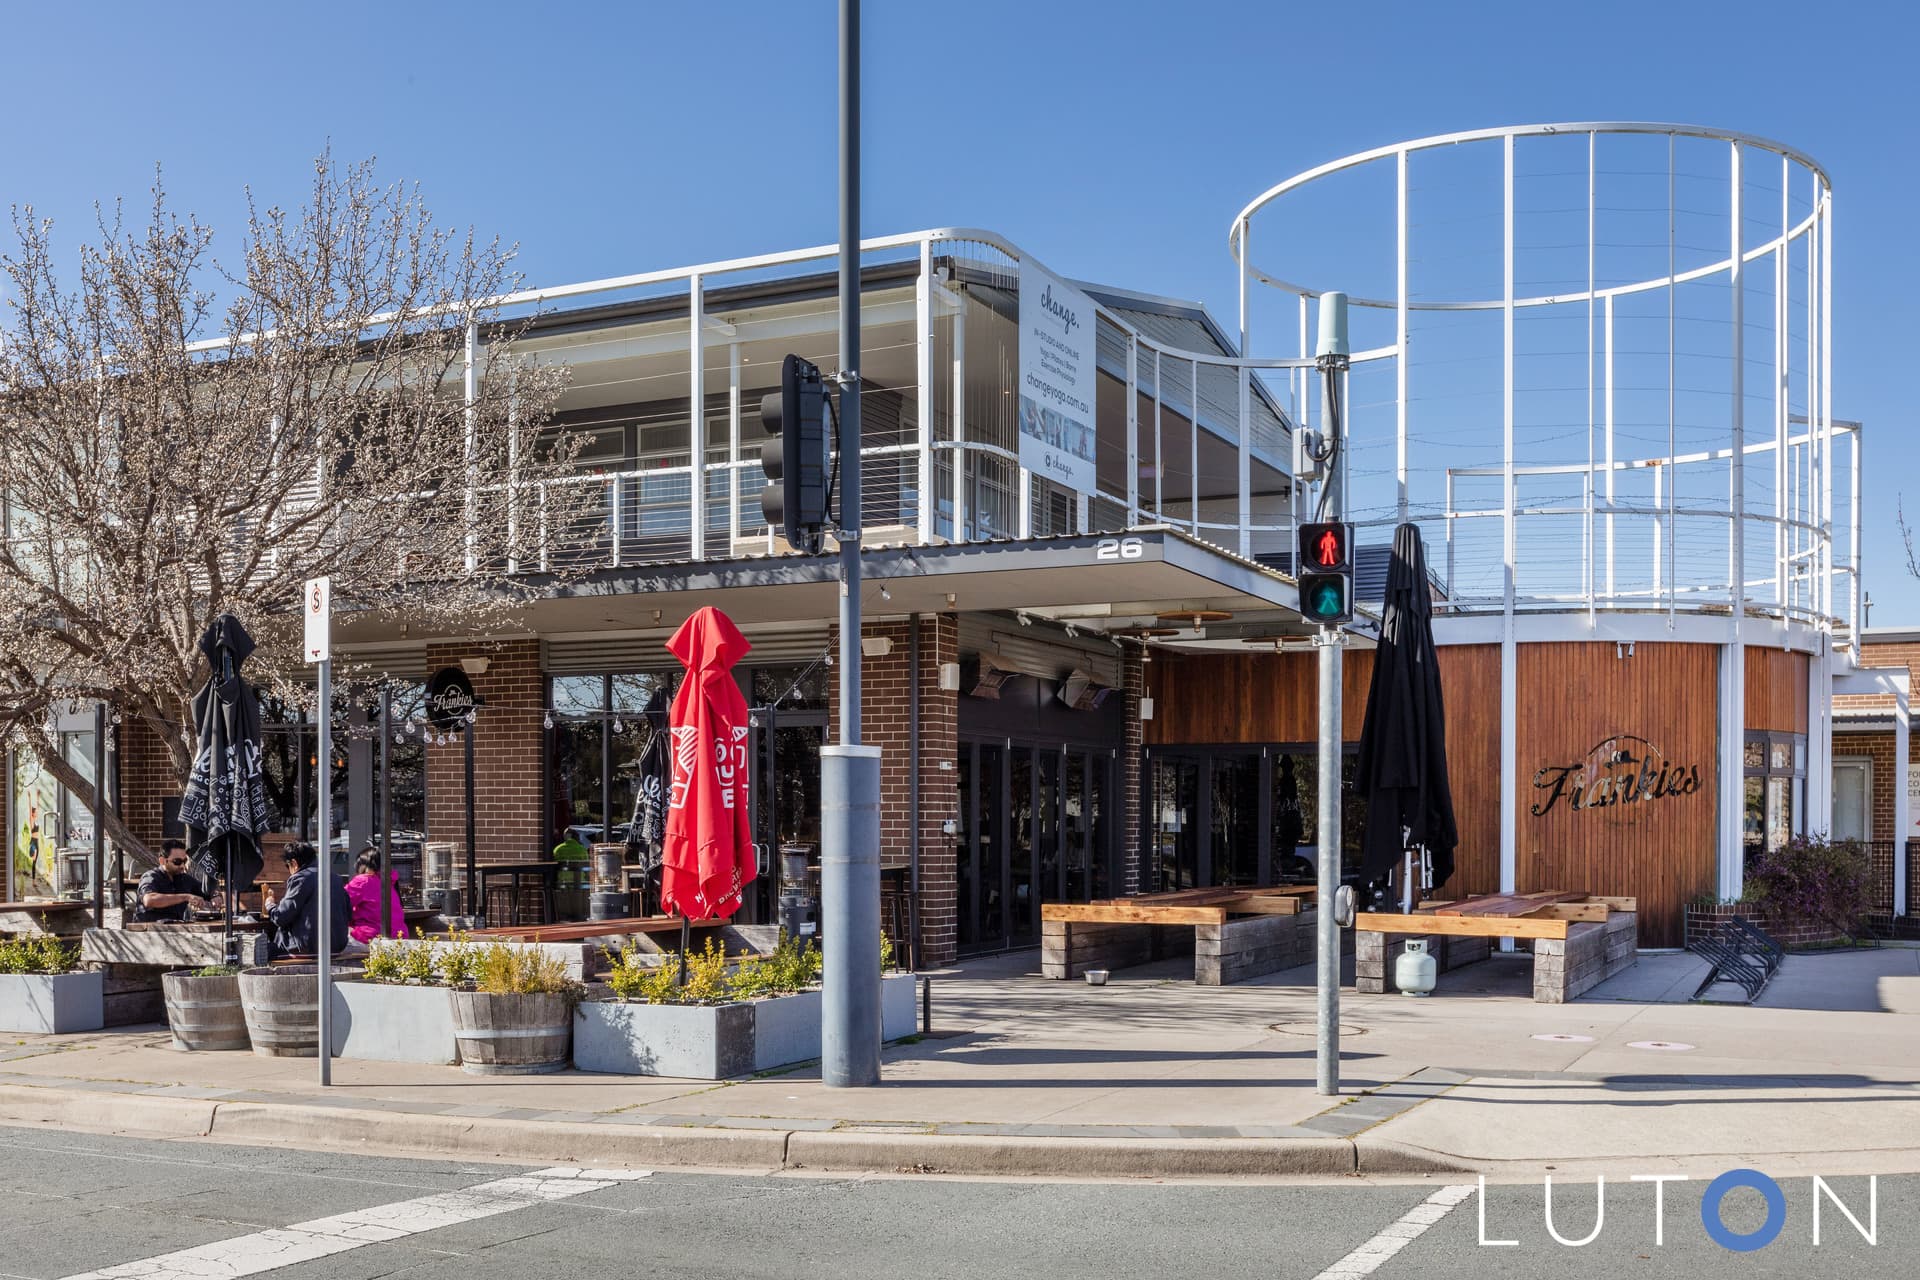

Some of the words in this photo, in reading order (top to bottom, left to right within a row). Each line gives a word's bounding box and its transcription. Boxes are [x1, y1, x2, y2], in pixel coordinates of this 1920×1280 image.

[1041, 284, 1080, 335] change.
[1026, 371, 1089, 414] changeyoga.com.au
[1097, 537, 1143, 560] 26
[433, 692, 473, 711] Frankies
[1531, 755, 1702, 817] Frankies
[1908, 770, 1920, 778] FO
